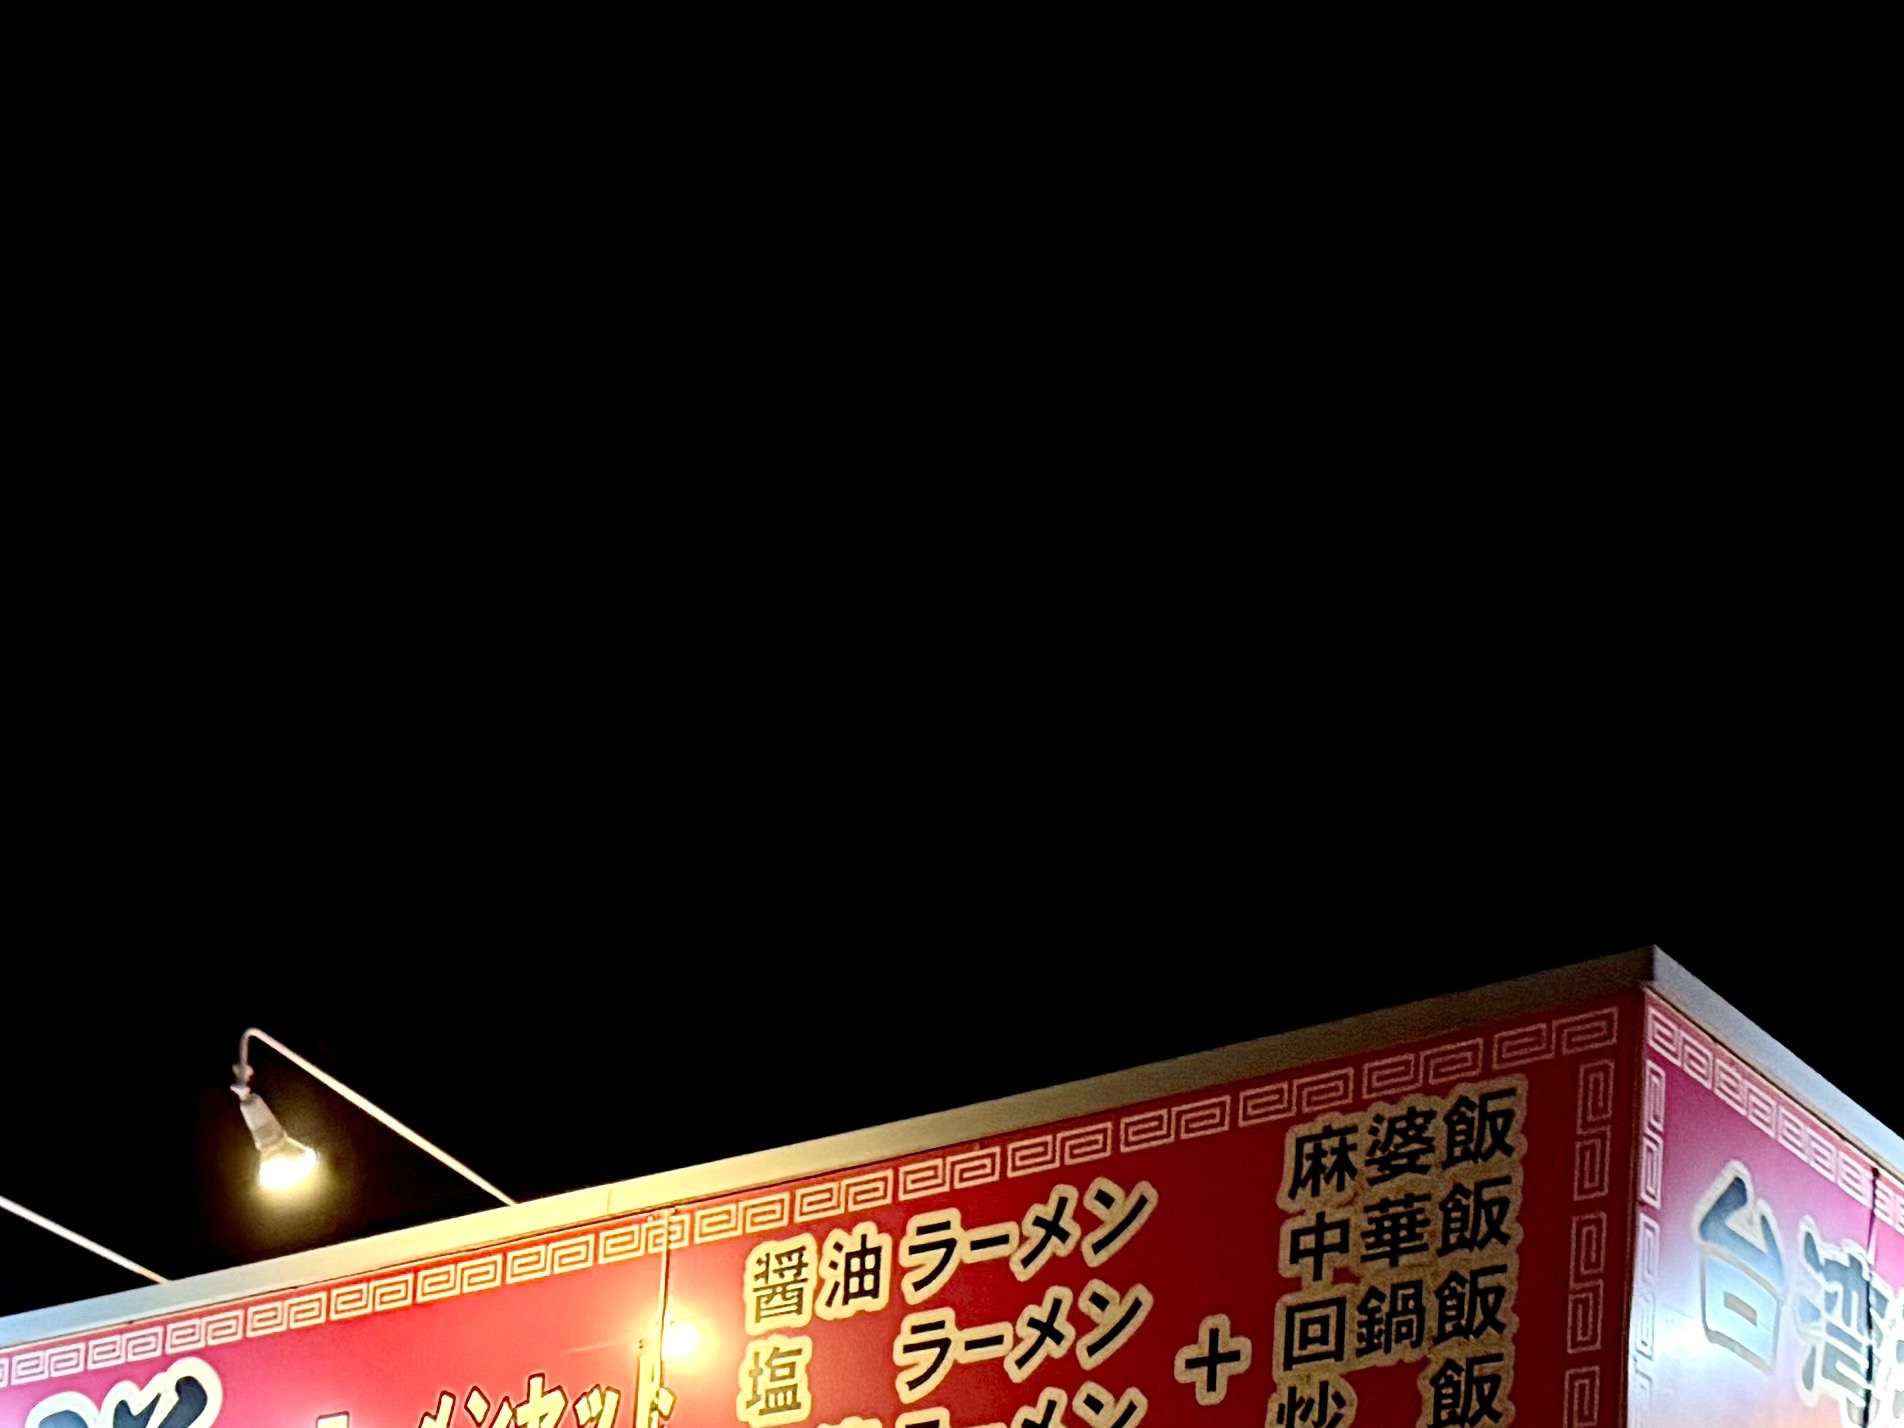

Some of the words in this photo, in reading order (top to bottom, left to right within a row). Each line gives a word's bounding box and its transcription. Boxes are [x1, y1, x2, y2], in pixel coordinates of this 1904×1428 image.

[1286, 1078, 1526, 1201] 麻婆飯
[746, 1179, 1157, 1331] 醤油ラーメン
[1281, 1174, 1522, 1284] 中華飯
[1276, 1263, 1515, 1378] 回鍋飯
